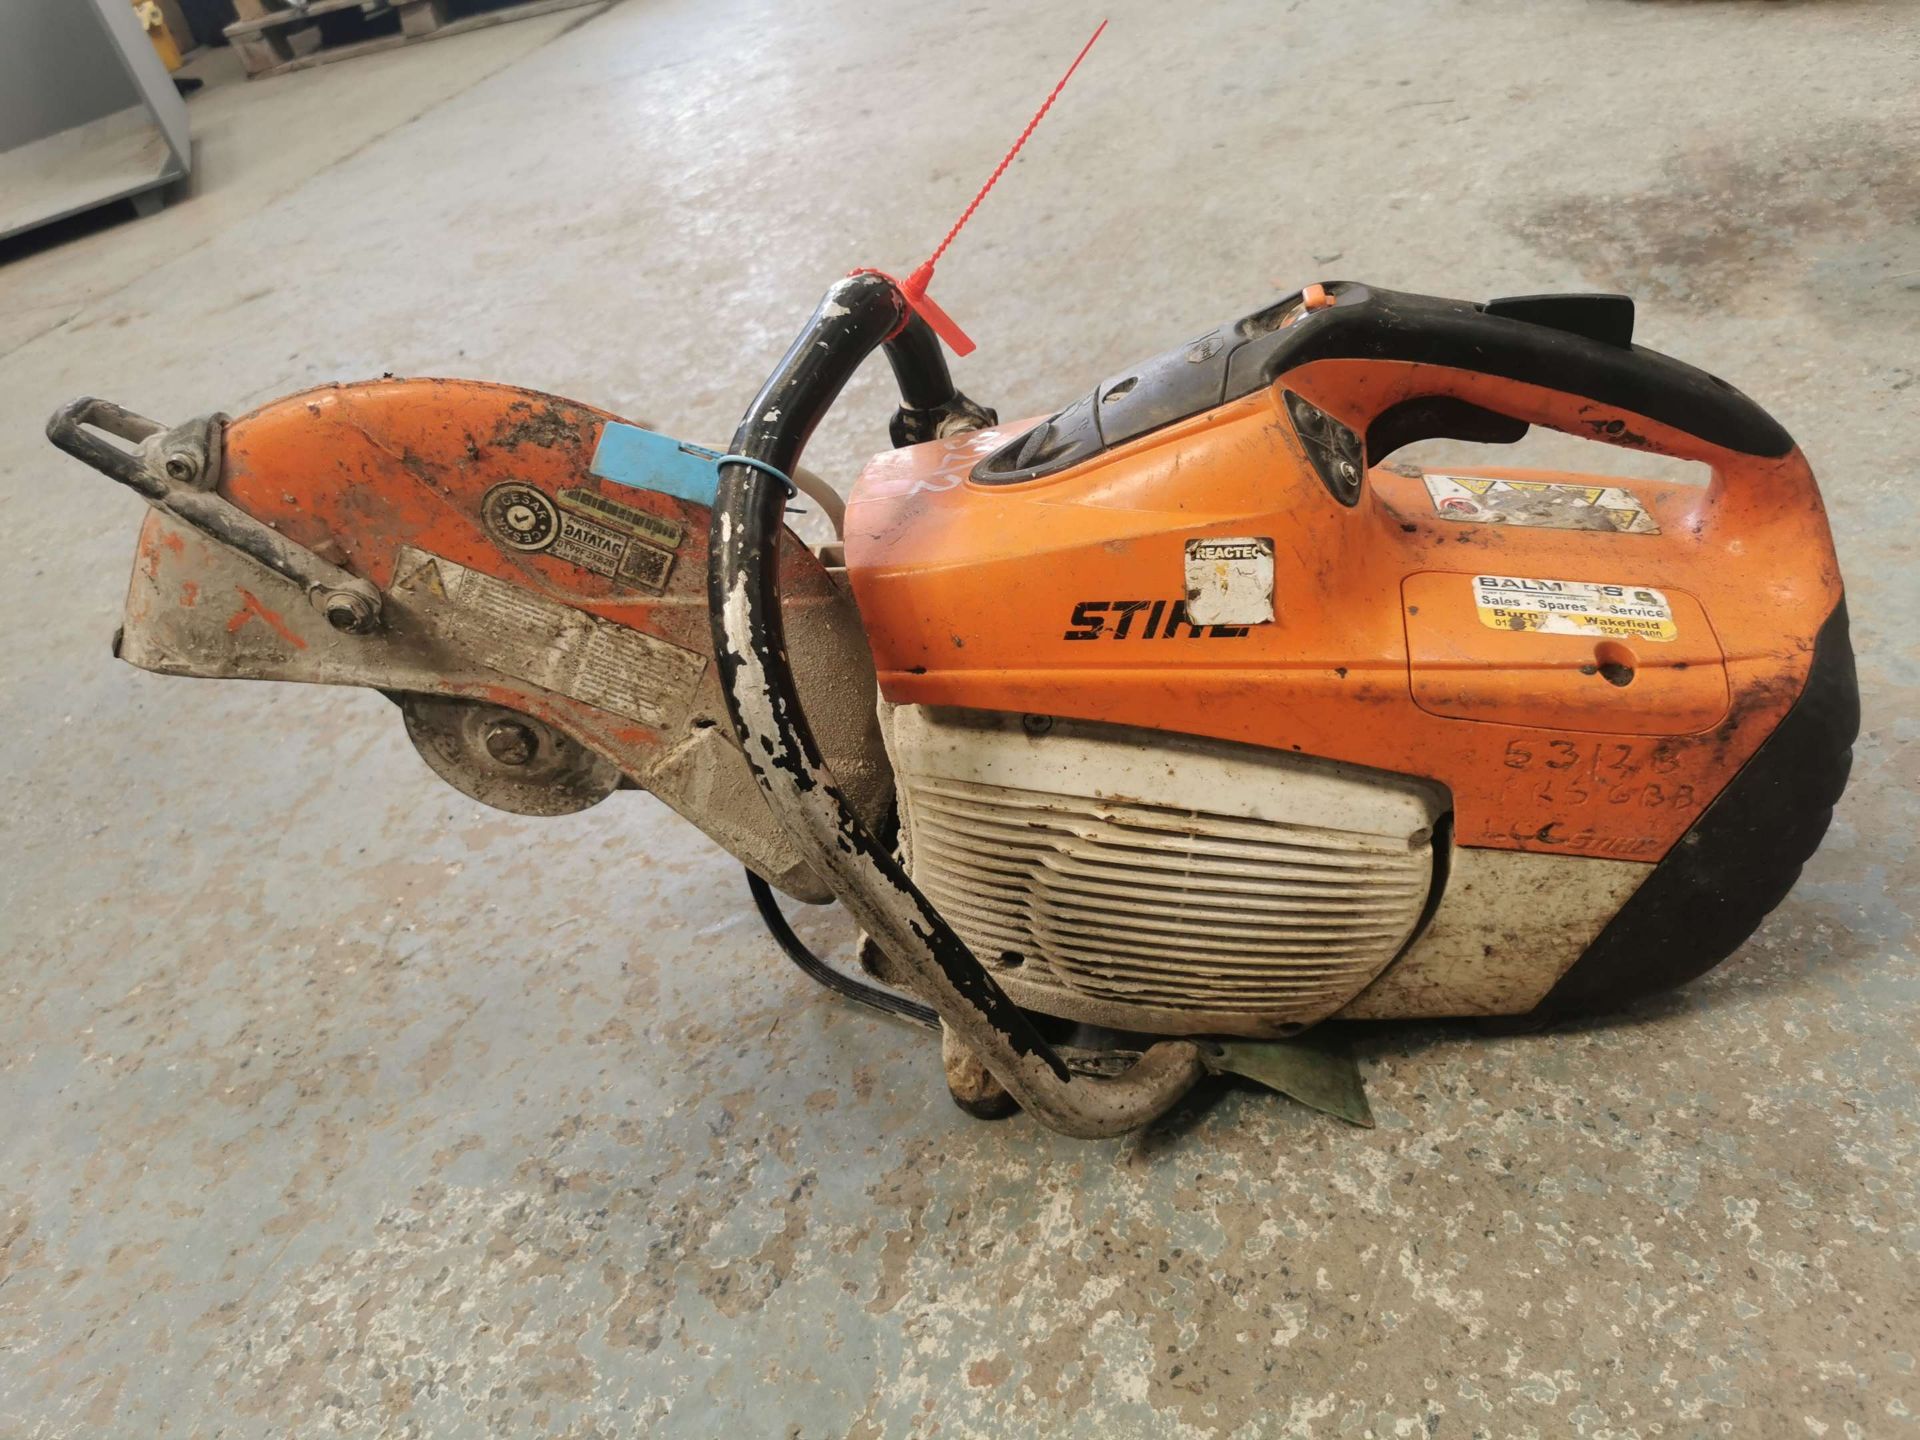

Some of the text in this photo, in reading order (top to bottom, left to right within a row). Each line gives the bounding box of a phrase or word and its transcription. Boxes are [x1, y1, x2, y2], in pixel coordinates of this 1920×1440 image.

[1478, 576, 1624, 597] BALMS
[1481, 595, 1521, 608] Sales
[1538, 599, 1588, 613] Spares
[1609, 604, 1665, 618] Service
[1584, 616, 1661, 630] Wakefield
